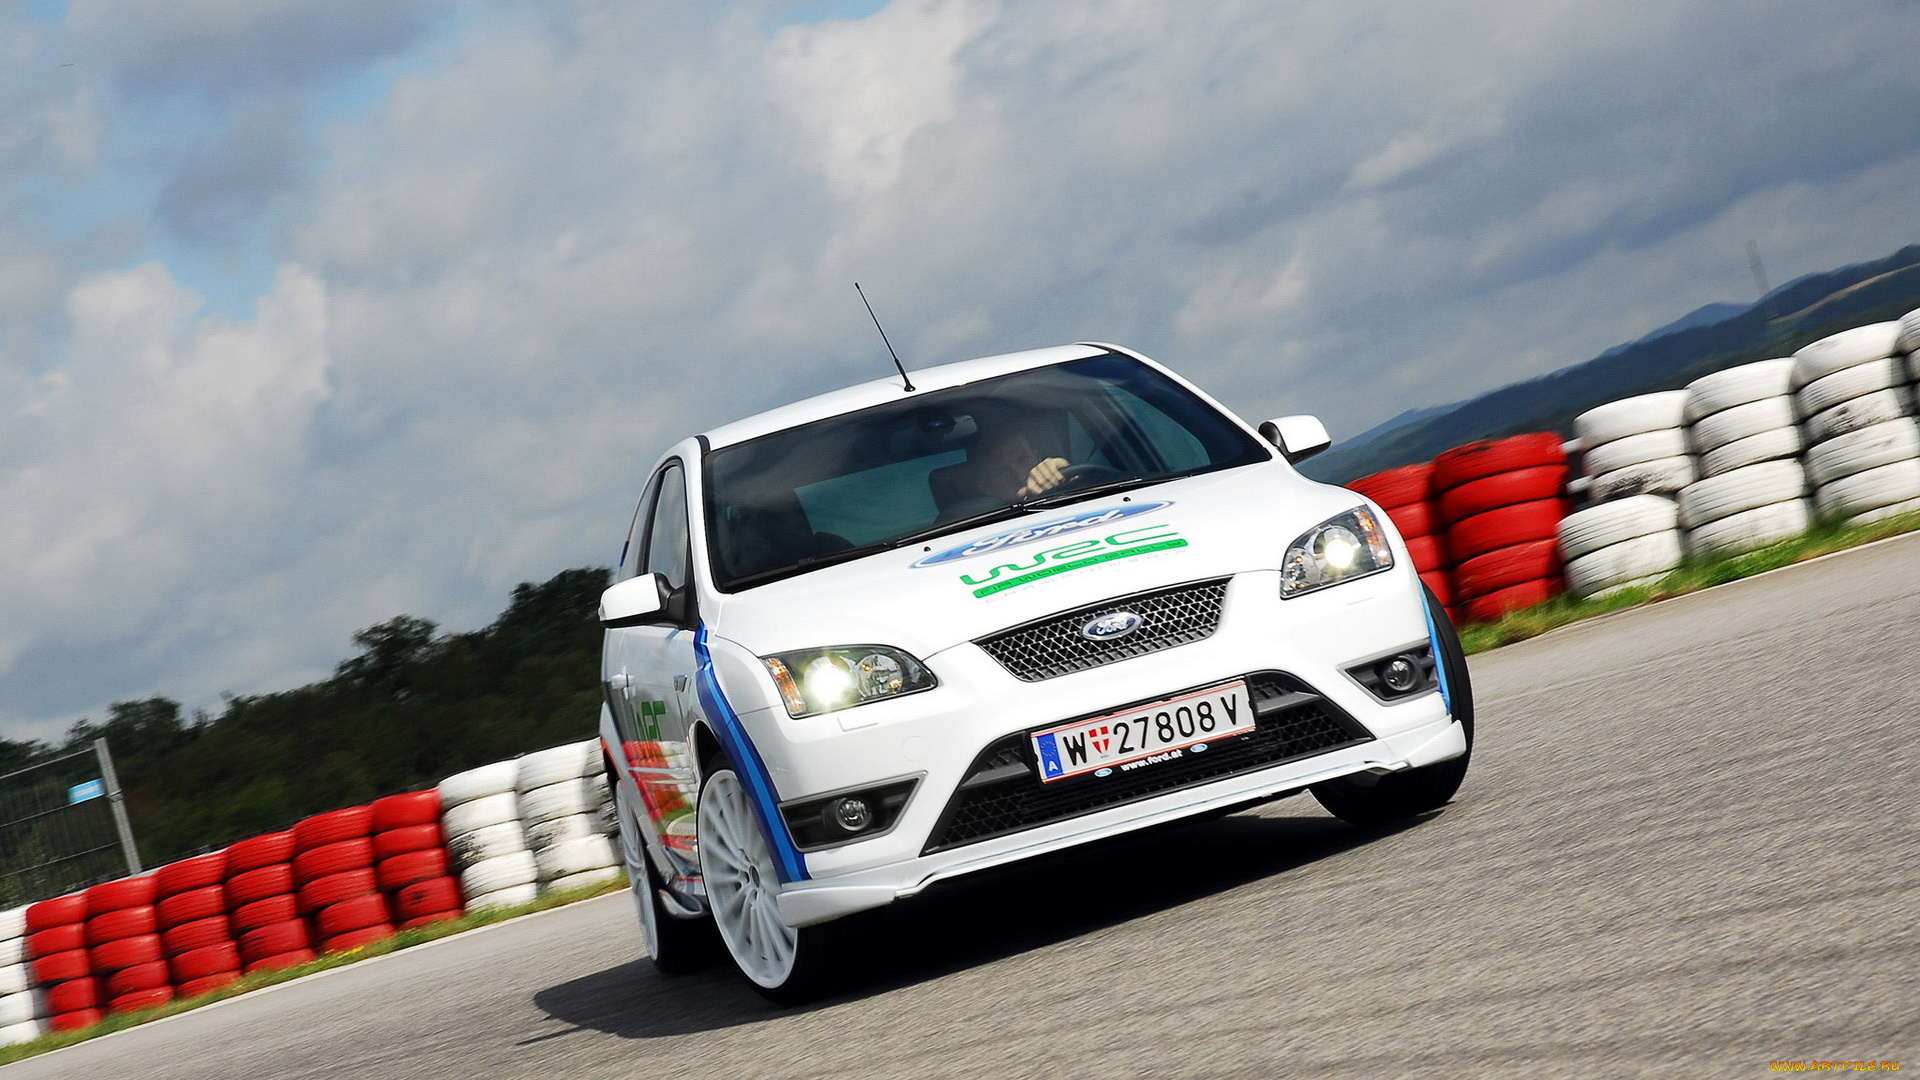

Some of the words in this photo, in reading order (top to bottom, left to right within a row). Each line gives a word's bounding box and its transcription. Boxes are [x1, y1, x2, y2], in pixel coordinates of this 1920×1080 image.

[959, 523, 1180, 585] WRC
[962, 509, 1125, 557] Ford
[980, 579, 1013, 595] FIA
[1018, 556, 1097, 582] WORLD
[1104, 540, 1182, 561] RALLY
[1063, 731, 1088, 766] W
[1113, 701, 1216, 754] 27808
[1220, 693, 1237, 726] V
[1048, 760, 1059, 772] A
[1120, 749, 1183, 771] www.ford.at
